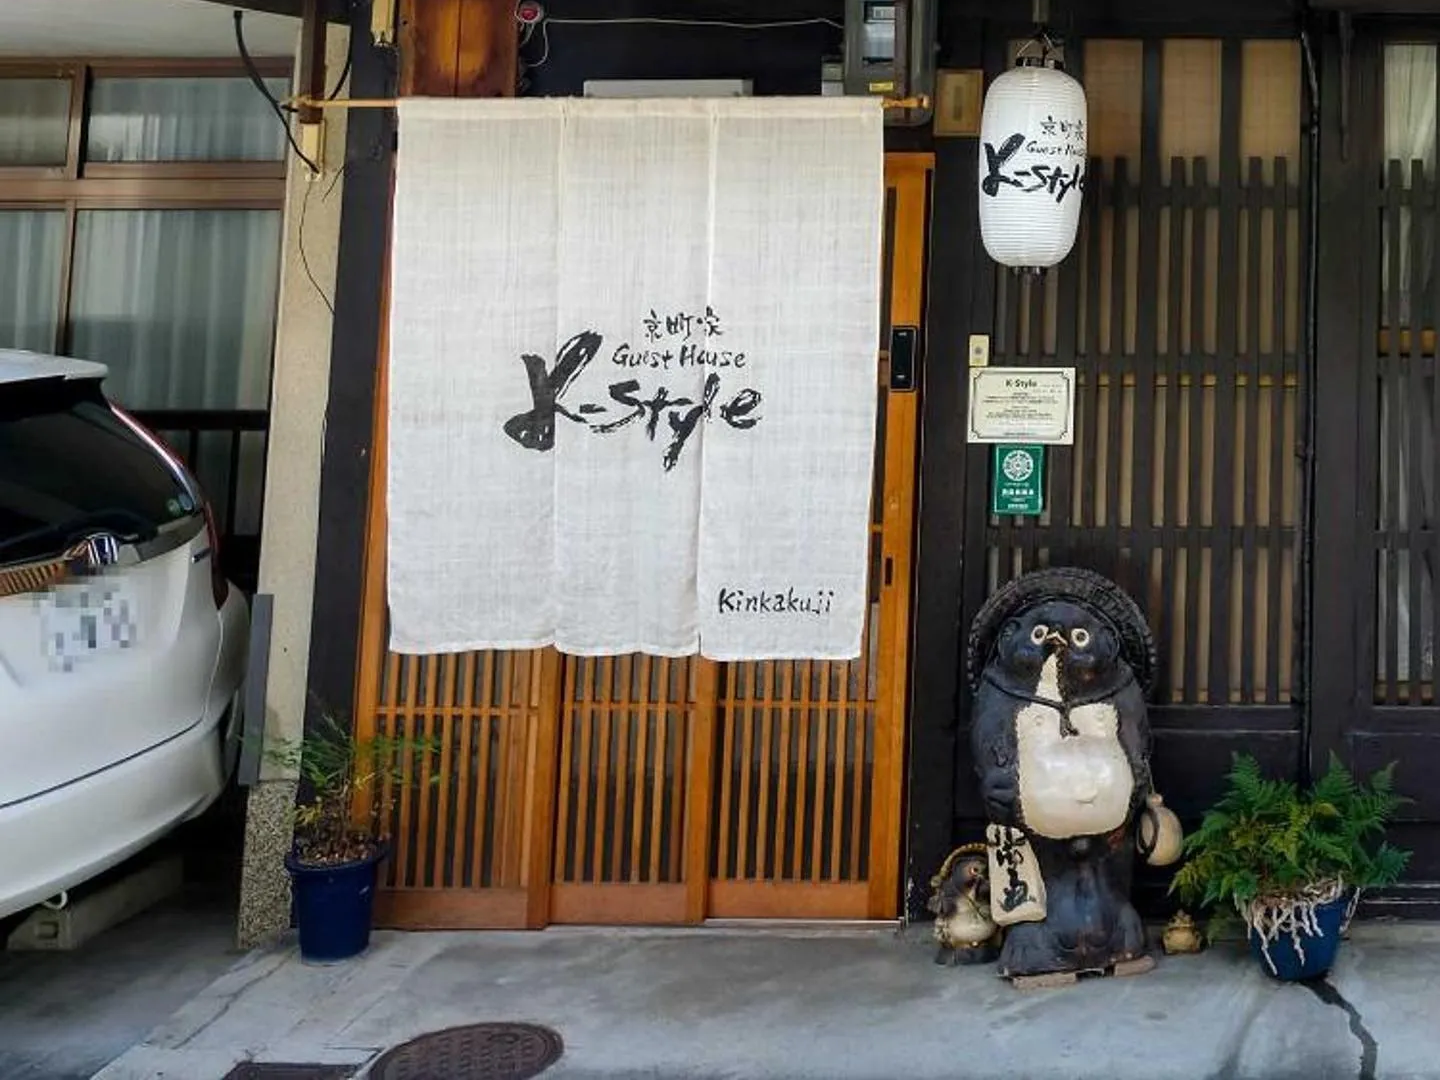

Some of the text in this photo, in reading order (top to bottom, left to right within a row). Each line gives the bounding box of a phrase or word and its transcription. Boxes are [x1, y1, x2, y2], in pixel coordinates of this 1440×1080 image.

[612, 343, 746, 369] Guest House
[719, 586, 834, 614] Kinkakuji
